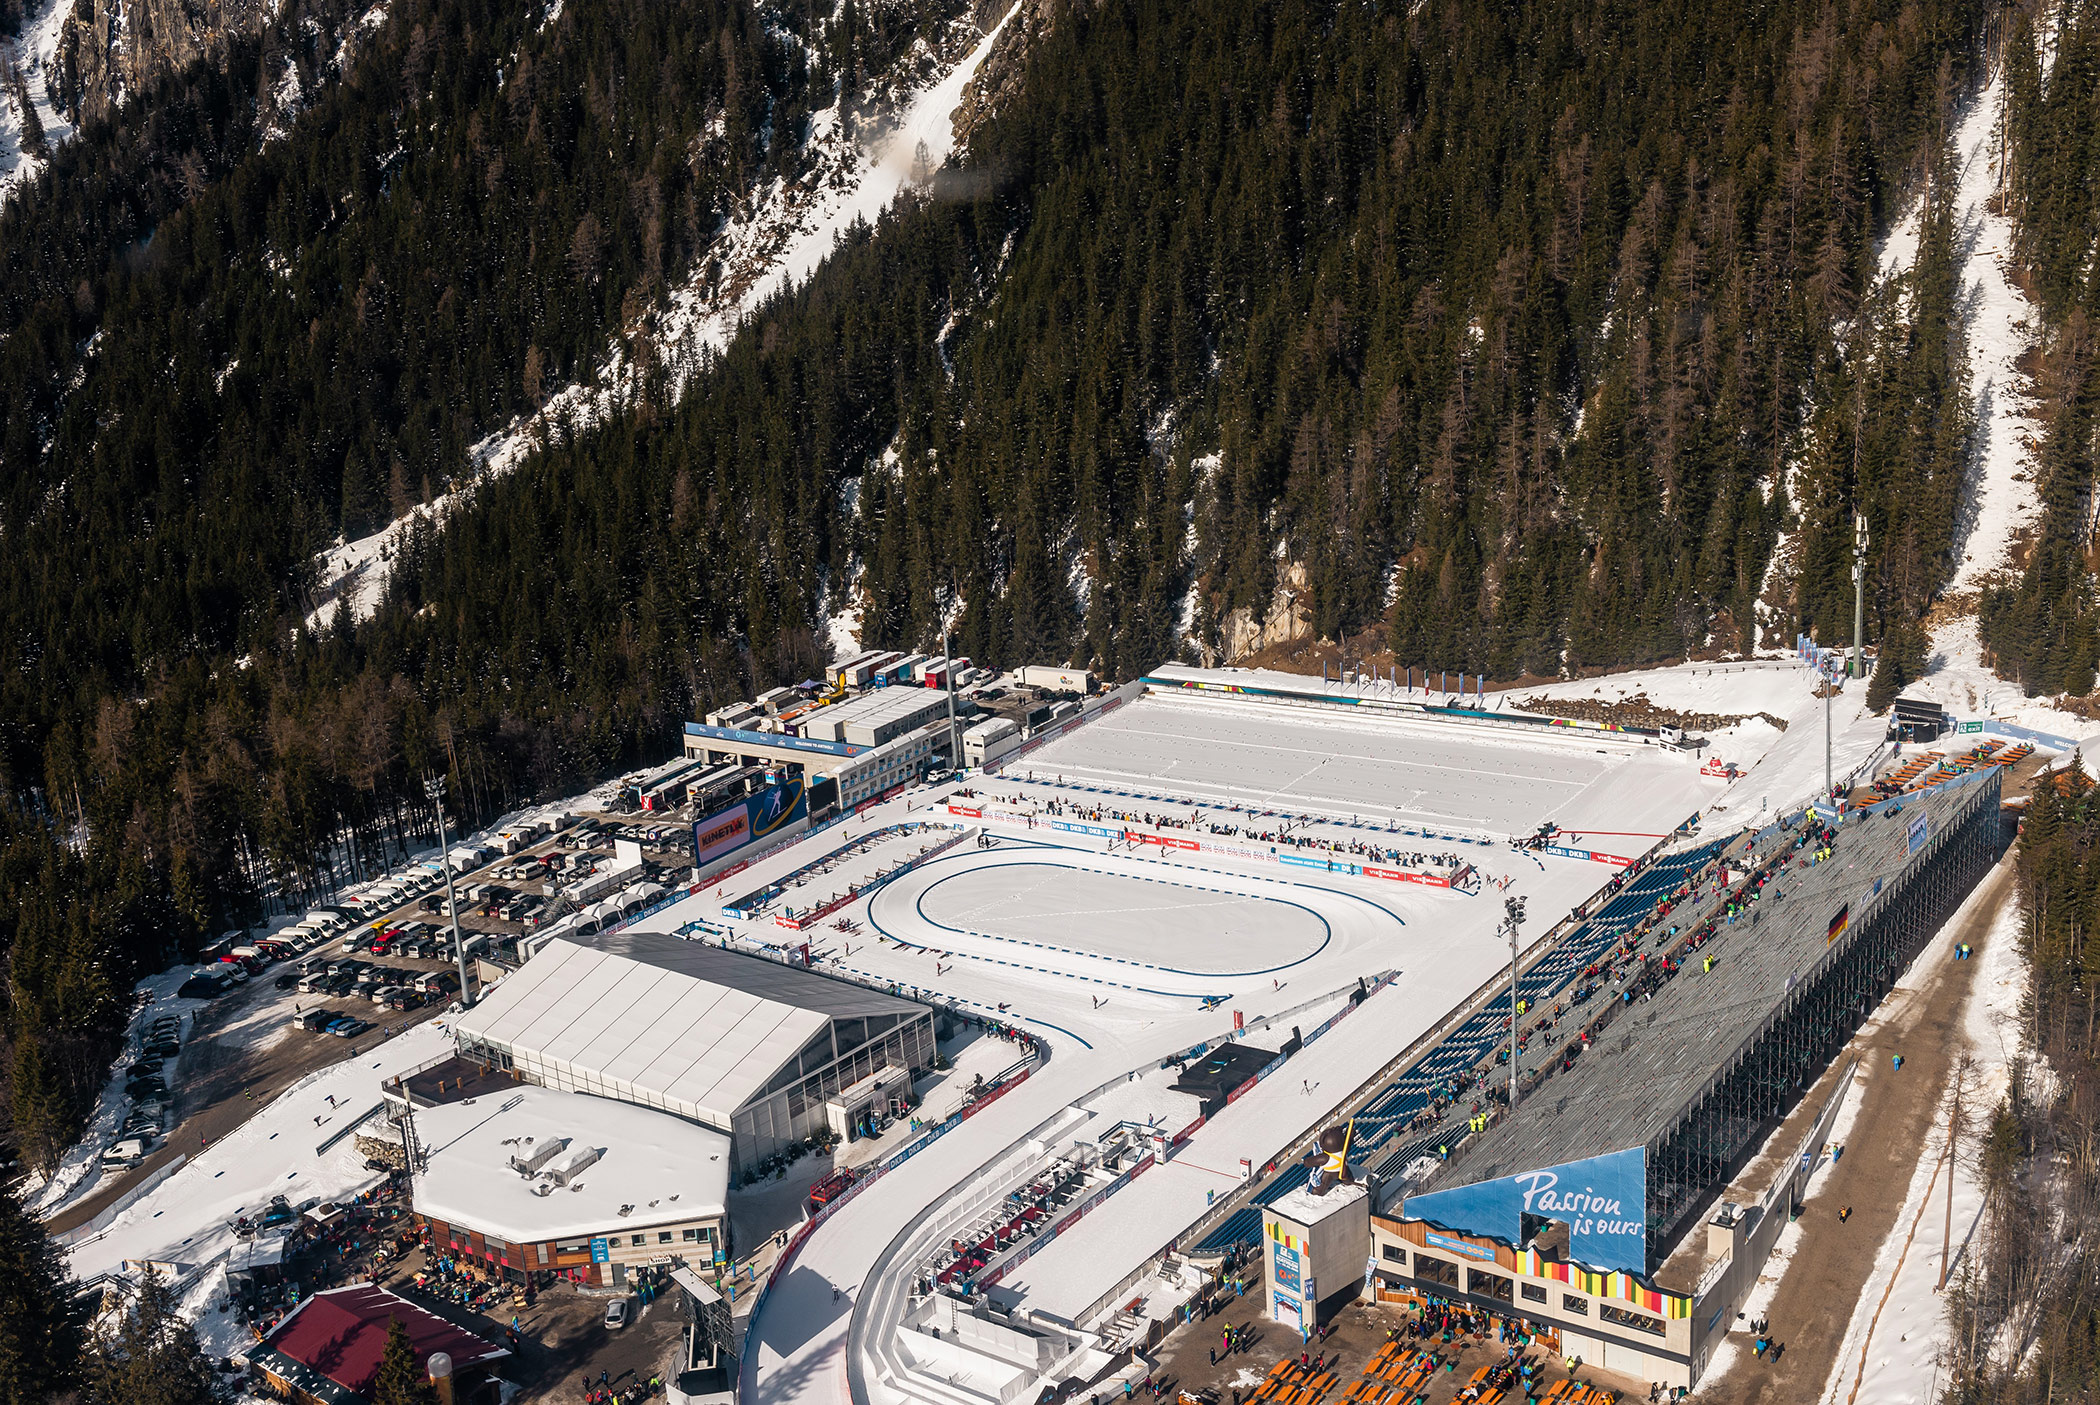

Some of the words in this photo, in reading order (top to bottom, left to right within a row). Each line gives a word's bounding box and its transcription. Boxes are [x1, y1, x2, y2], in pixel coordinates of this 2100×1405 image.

[1369, 869, 1399, 879] VIESSMANN
[1412, 876, 1443, 885] VIESSMANN
[890, 1155, 903, 1169] DKB
[908, 1143, 920, 1156] DKB
[927, 1130, 940, 1144] DKB
[944, 1118, 957, 1132] DKB
[1515, 1171, 1621, 1215] Passion
[1572, 1213, 1594, 1236] is
